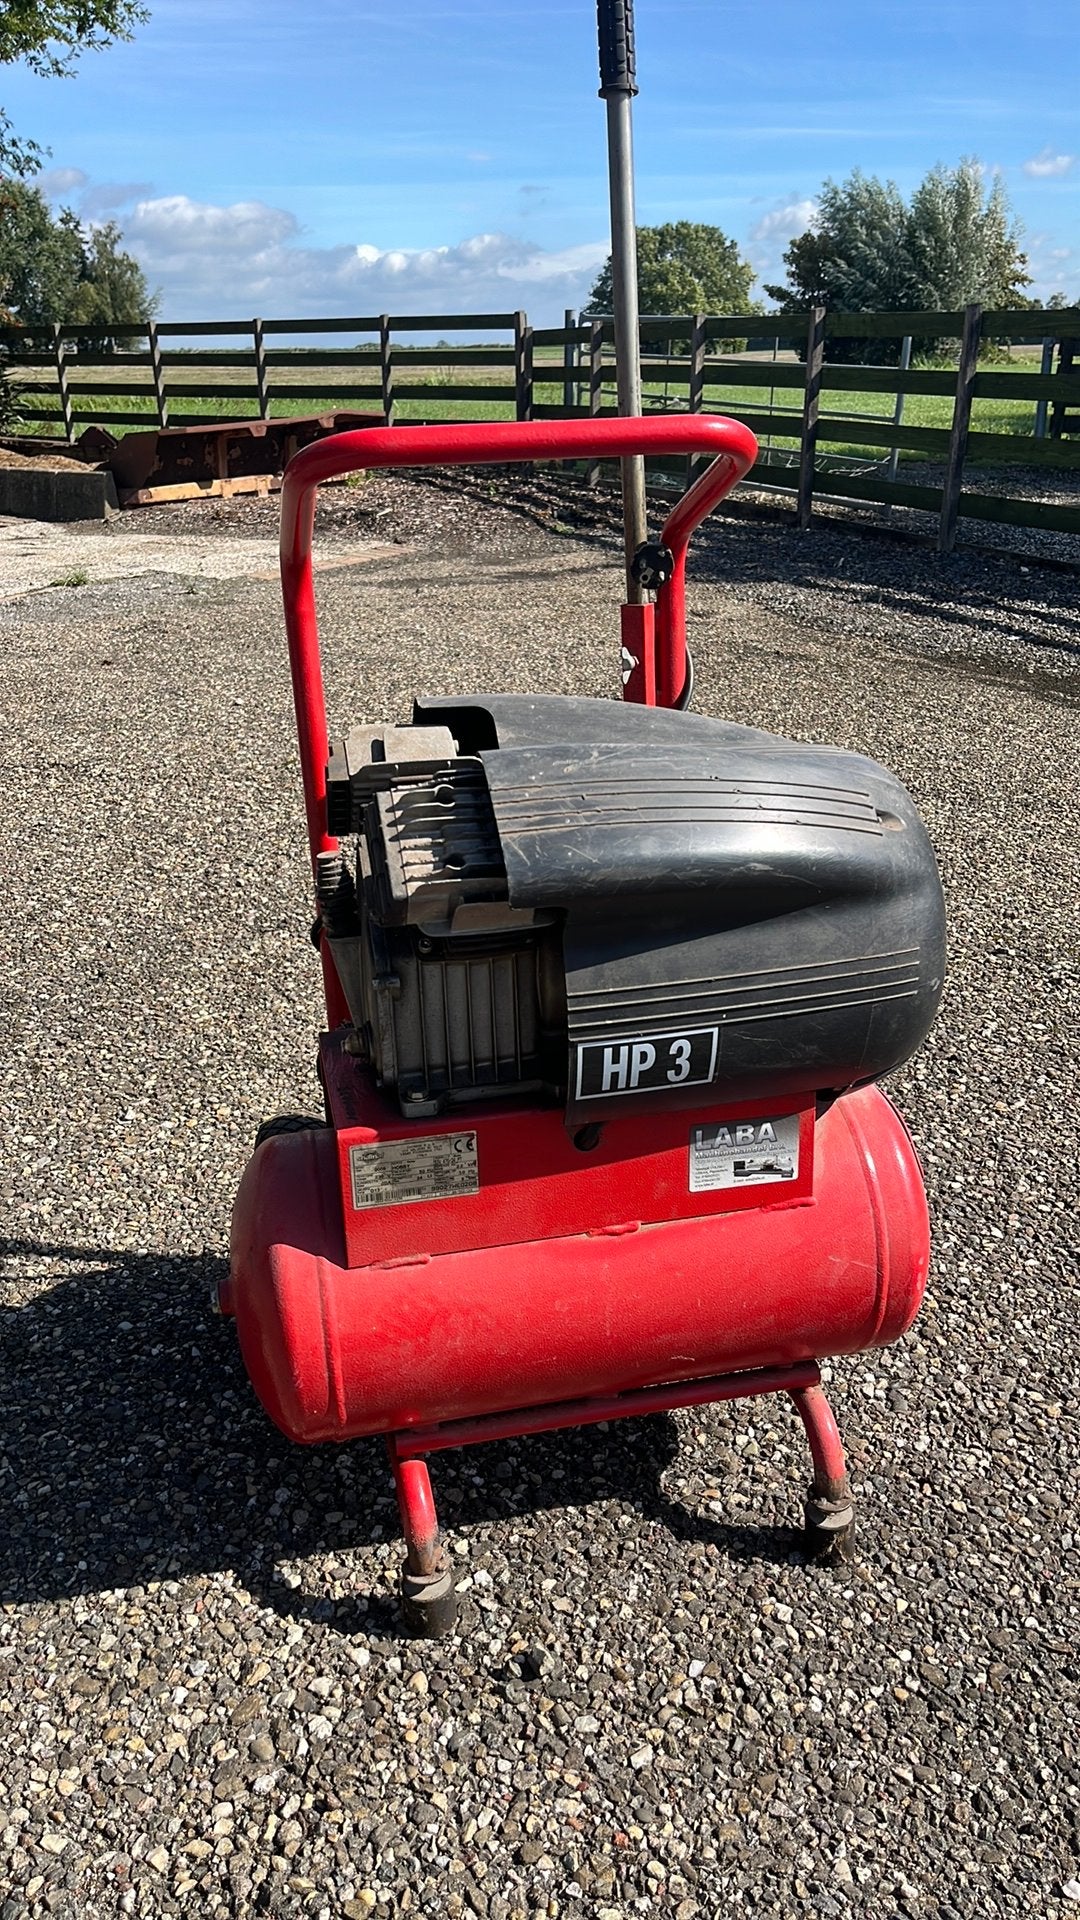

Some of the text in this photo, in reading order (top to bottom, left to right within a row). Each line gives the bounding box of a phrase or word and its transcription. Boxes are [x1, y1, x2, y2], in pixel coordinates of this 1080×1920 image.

[602, 1038, 692, 1091] HP 3
[695, 1122, 777, 1151] LABA
